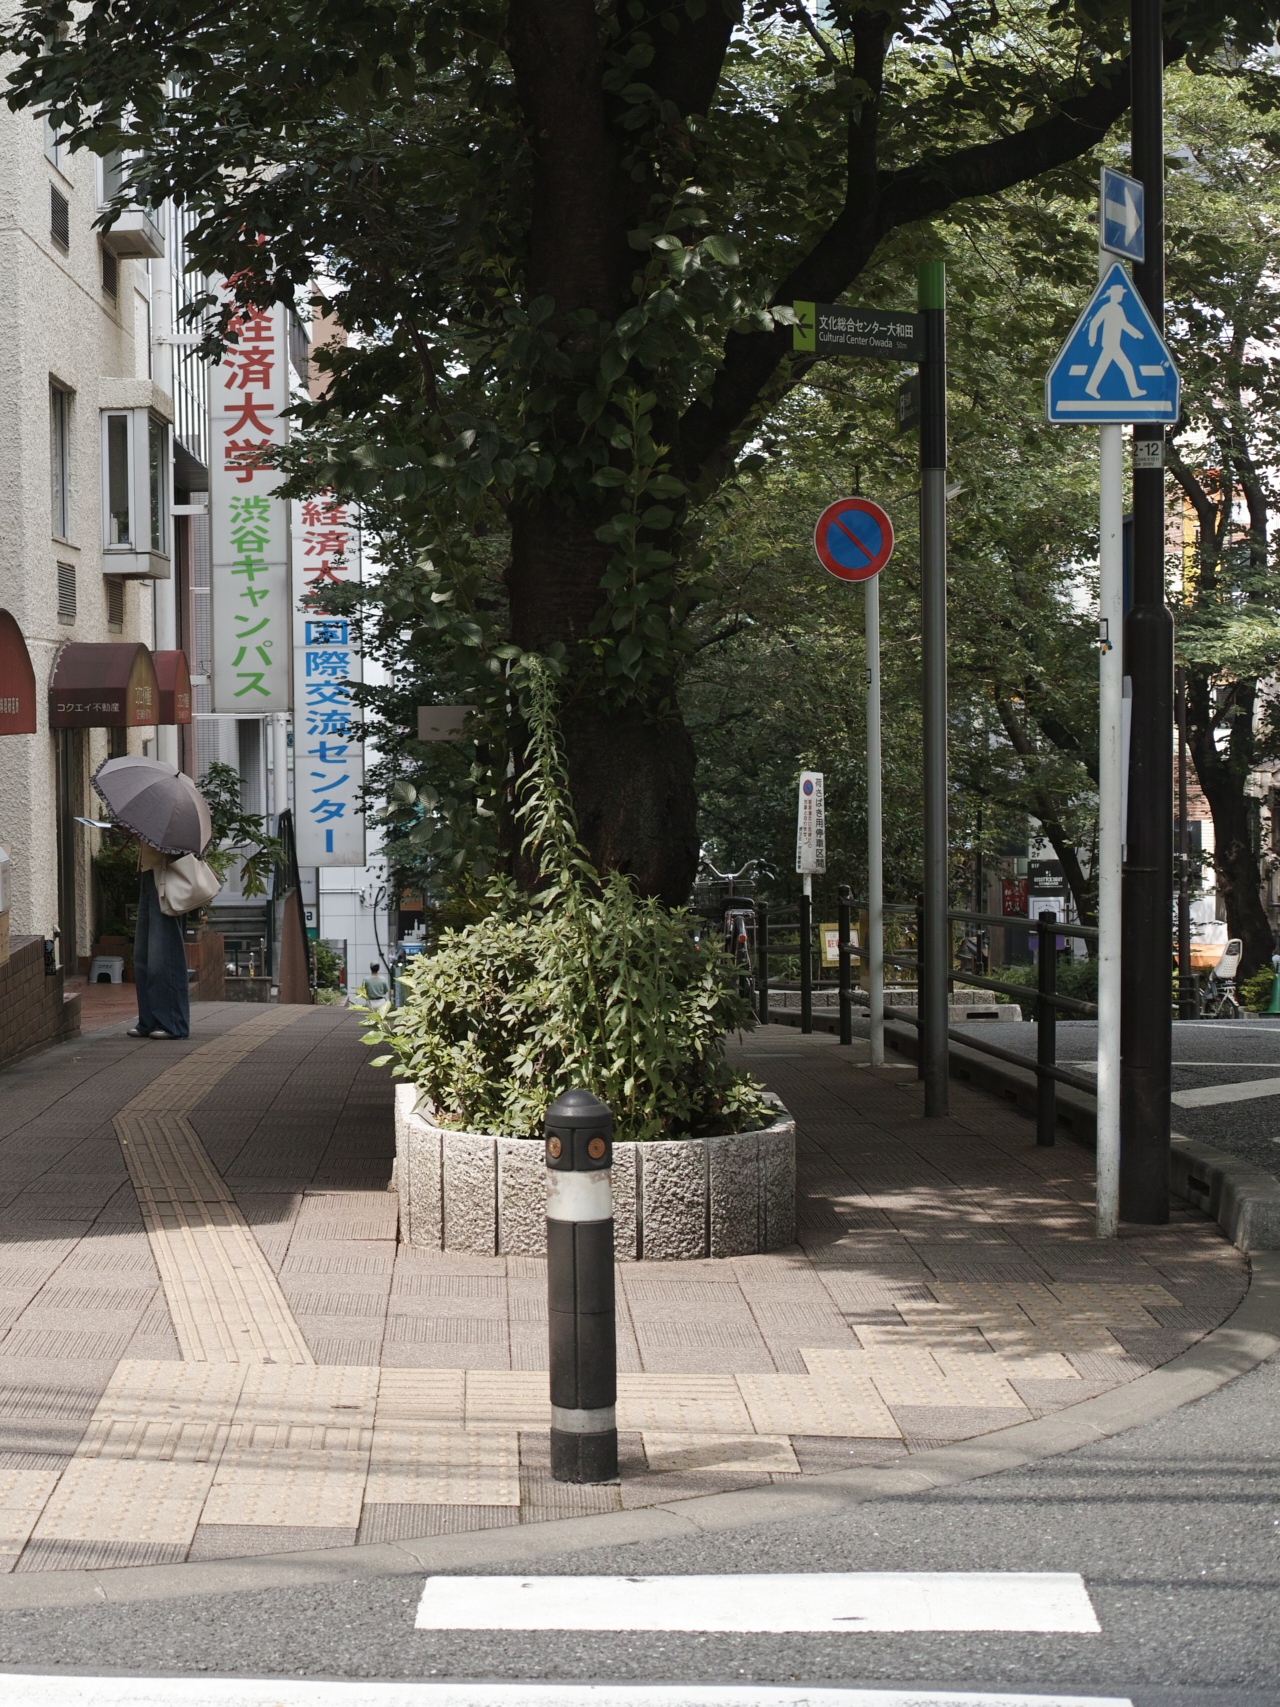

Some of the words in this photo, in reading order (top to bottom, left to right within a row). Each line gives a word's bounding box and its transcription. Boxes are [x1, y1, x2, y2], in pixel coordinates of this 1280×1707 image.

[818, 315, 914, 339] 文化総合センター大和田
[818, 331, 846, 344] Cultural
[846, 334, 869, 346] Center
[869, 336, 893, 348] Owada
[229, 494, 273, 698] 渋谷キャンパス
[56, 703, 120, 713] コクエイ不動産
[815, 778, 825, 869] 荷さばき用停車区間
